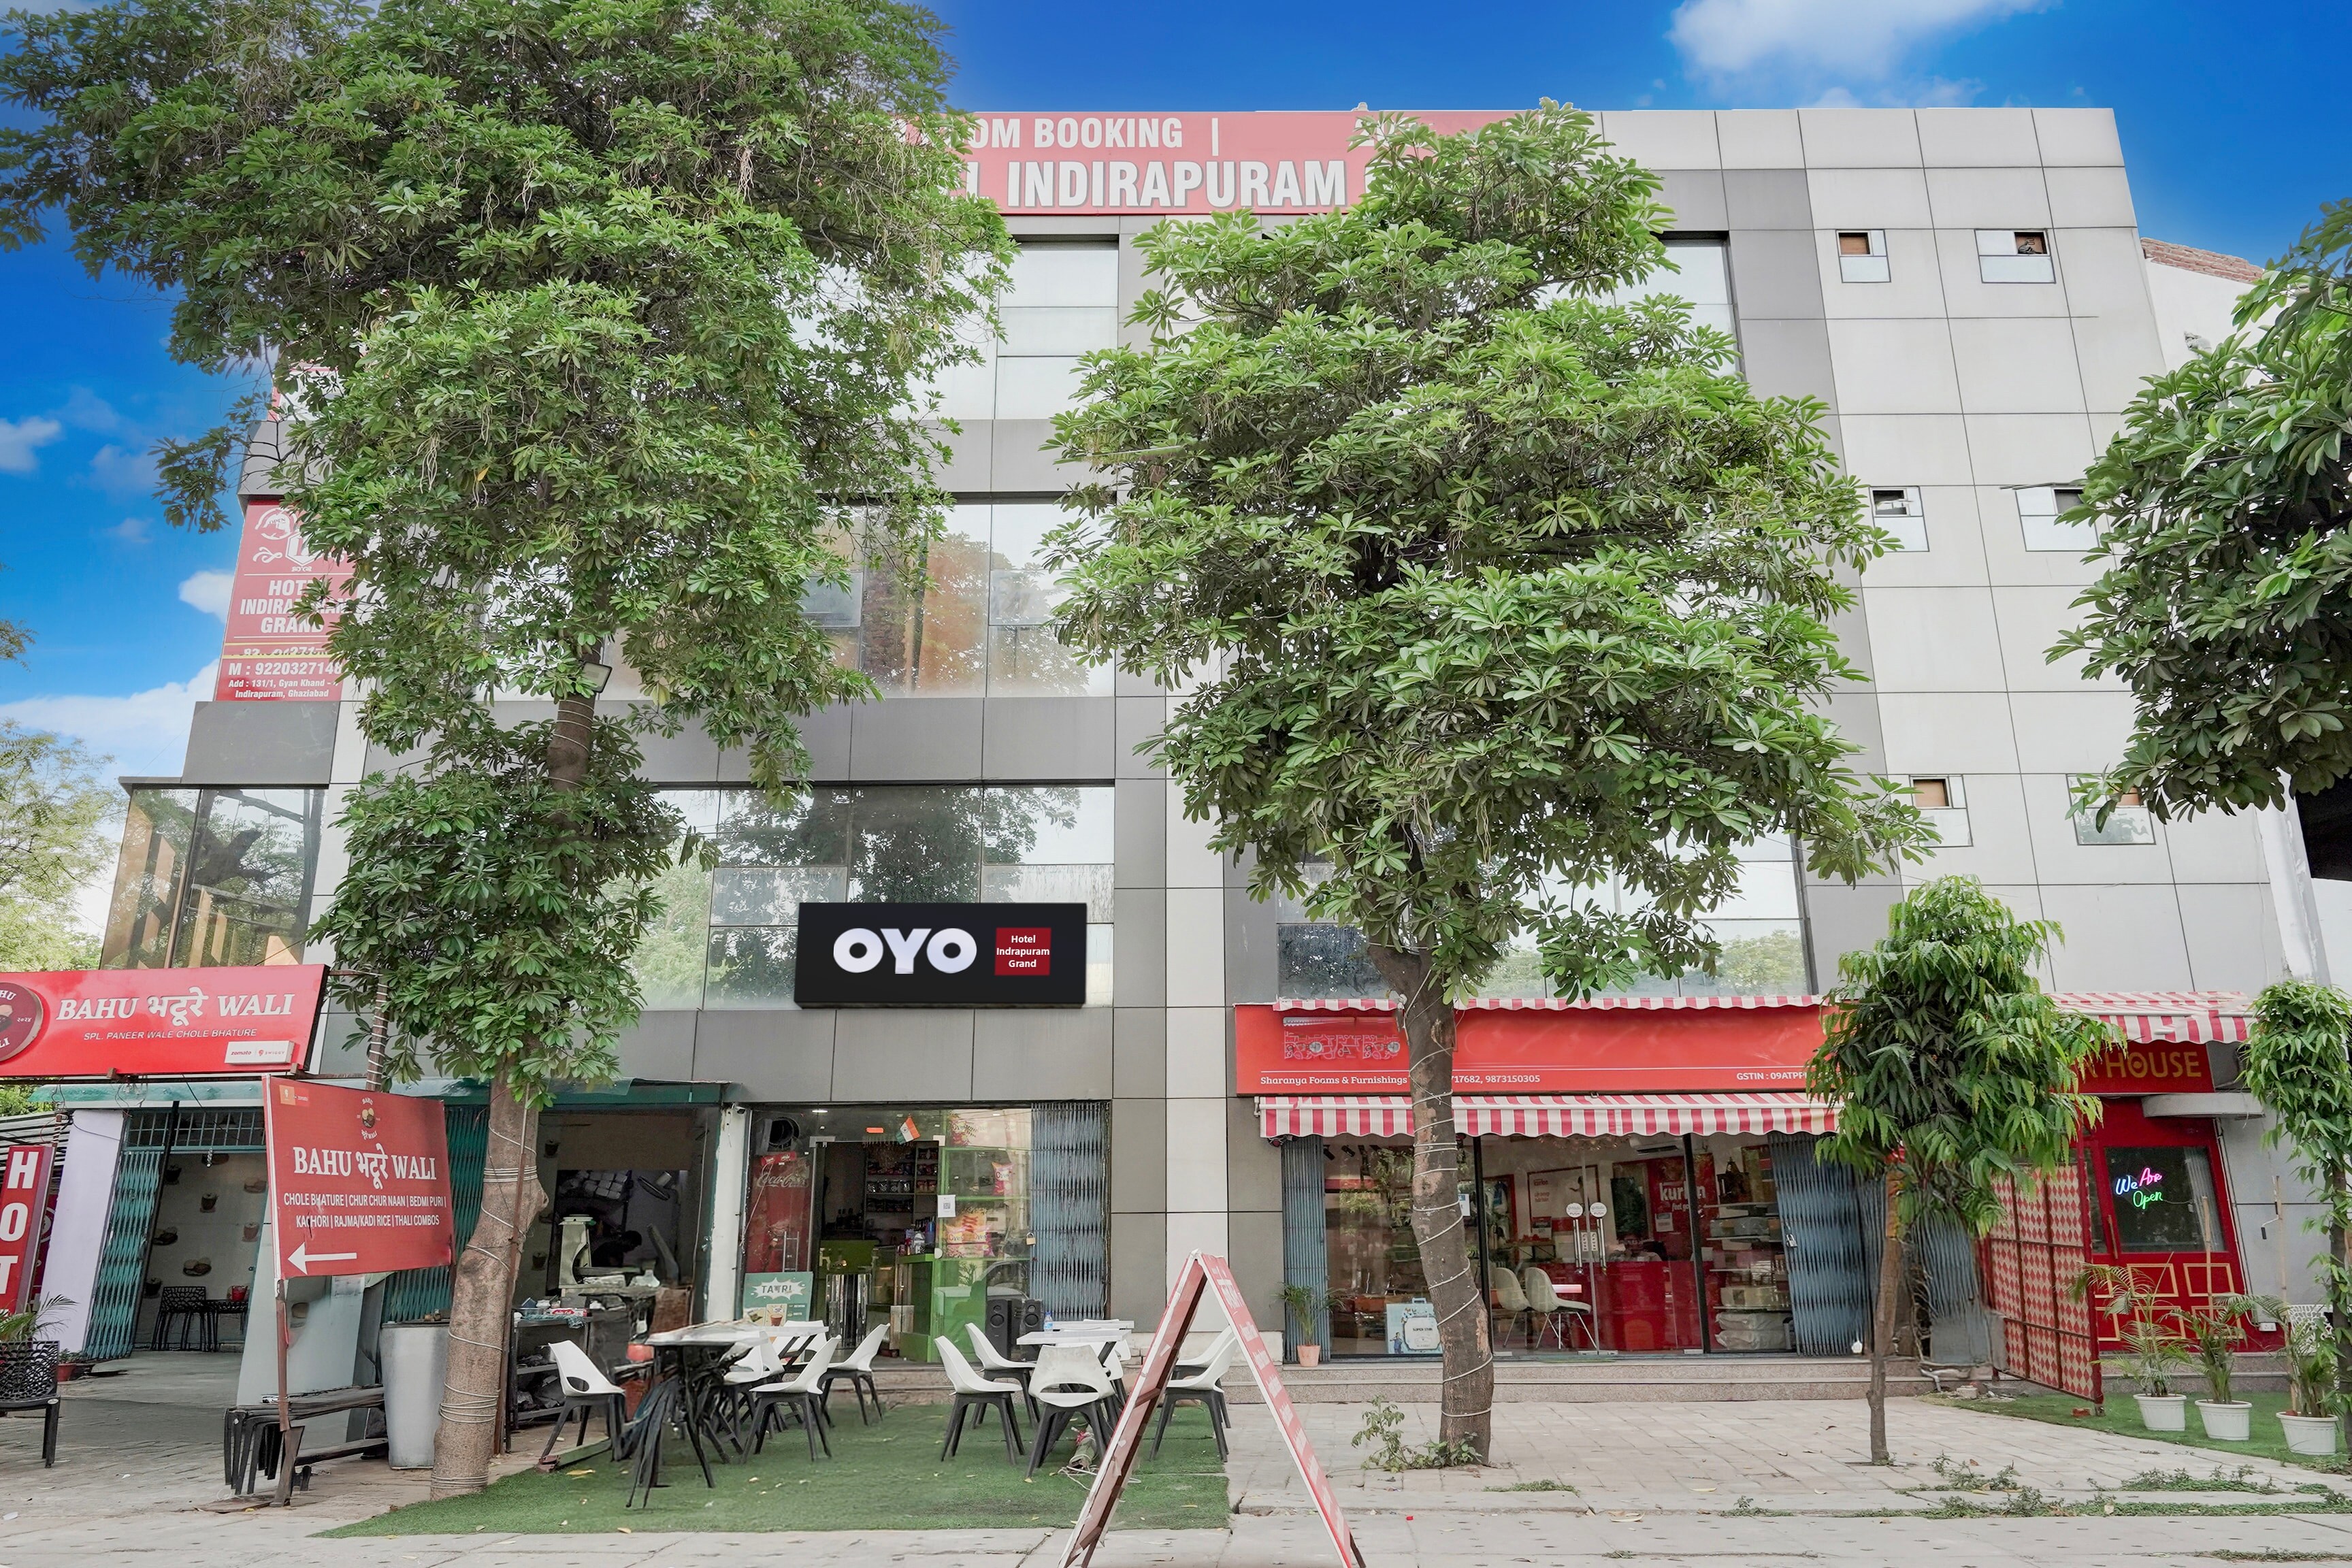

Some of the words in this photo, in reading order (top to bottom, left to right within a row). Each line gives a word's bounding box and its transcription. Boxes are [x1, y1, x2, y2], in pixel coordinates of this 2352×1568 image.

[1034, 118, 1183, 149] BOOKING
[1007, 160, 1347, 209] INDIRAPURAM
[268, 580, 316, 596] HOT
[228, 663, 243, 676] M
[255, 662, 342, 675] 9220327148
[252, 679, 276, 688] 131/1,
[278, 679, 298, 688] Gyan
[300, 679, 325, 687] Khand
[235, 689, 286, 699] Indirapuram,
[288, 689, 329, 698] Ghaziabad
[1011, 934, 1036, 943] Hotel
[833, 928, 977, 974] OYO
[996, 947, 1050, 958] Indrapuram
[1009, 959, 1036, 968] Grand
[0, 990, 17, 1000] HU
[56, 998, 140, 1020] BAHU
[146, 986, 209, 1026] भटूरे
[217, 994, 295, 1017] WALI
[84, 1032, 103, 1041] SPL.
[106, 1032, 144, 1040] PANEER
[147, 1030, 174, 1039] WALE
[176, 1030, 209, 1038] CHOLE
[211, 1028, 257, 1037] BHATURE
[2104, 1051, 2202, 1078] HOUSE
[1260, 1076, 1307, 1085] Sharanya
[1309, 1076, 1340, 1084] Foams
[1341, 1076, 1349, 1084] &
[1351, 1075, 1407, 1085] Furnishings
[1485, 1075, 1541, 1083] 9873150305
[1737, 1072, 1764, 1080] GSTIN
[293, 1146, 352, 1177] BAHU
[355, 1143, 388, 1190] भटूरे
[391, 1155, 437, 1180] WALI
[757, 1171, 808, 1188] Coca-C
[2115, 1175, 2138, 1195] We
[2139, 1167, 2163, 1187] Are
[1659, 1181, 1706, 1201] kurln
[284, 1192, 310, 1205] CHOLE
[310, 1193, 344, 1206] BHATURE
[348, 1194, 368, 1207] CHUR
[369, 1194, 387, 1207] CHUR
[388, 1195, 406, 1207] NAAN
[410, 1196, 429, 1207] BEDMI
[429, 1196, 444, 1207] PURI
[2133, 1190, 2163, 1209] Open
[0, 1151, 39, 1294] HOT
[334, 1214, 376, 1228] RAJMA/KADI
[376, 1215, 391, 1226] RICE
[395, 1214, 413, 1226] THALI
[413, 1214, 440, 1226] COMBOS
